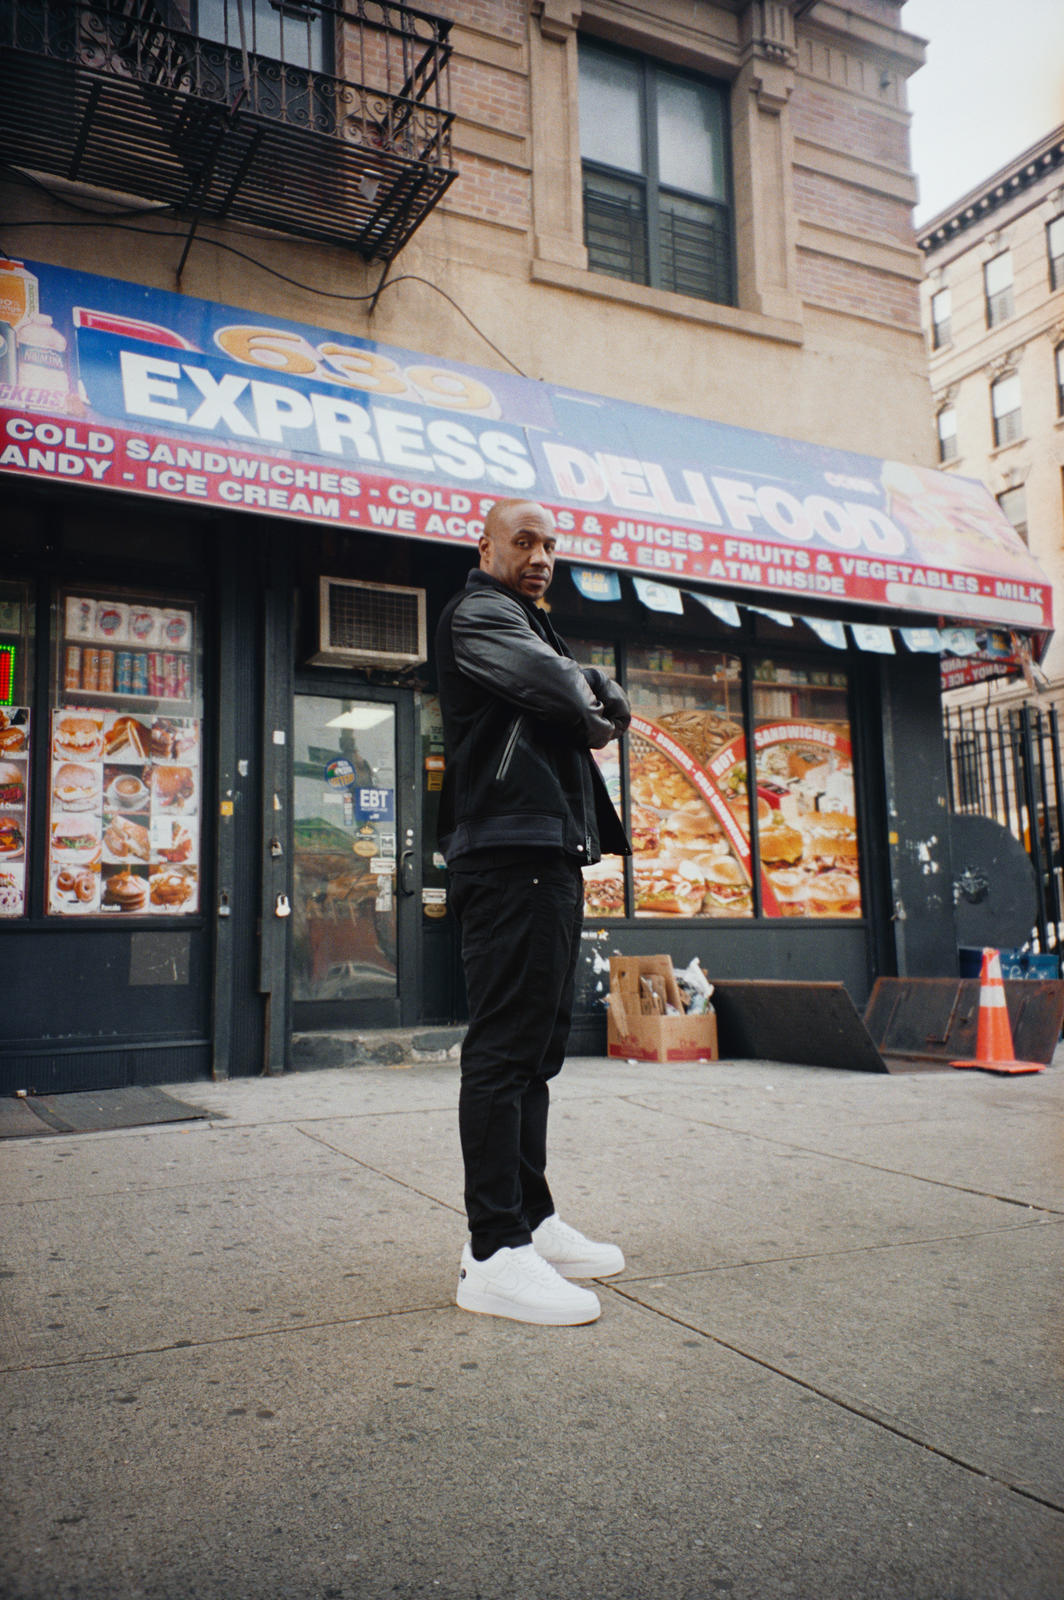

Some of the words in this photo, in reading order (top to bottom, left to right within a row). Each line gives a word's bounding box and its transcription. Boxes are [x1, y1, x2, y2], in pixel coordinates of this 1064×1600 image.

[214, 325, 500, 413] 639
[119, 350, 536, 490] EXPRESS
[541, 441, 724, 527] DELI
[711, 475, 906, 556] FOOD
[5, 418, 114, 453] COLD
[126, 438, 360, 497] SANDWICHES
[387, 485, 472, 514] COLD
[582, 515, 602, 536] &
[610, 520, 704, 552] JUICES
[724, 539, 810, 572] FRUITS
[816, 553, 833, 574] &
[838, 556, 979, 594] VEGETABLES
[995, 581, 1045, 605] MILK
[147, 468, 208, 496] ICE
[217, 480, 340, 518] CREAM
[367, 504, 416, 531] WE
[425, 512, 485, 539] ACC
[609, 542, 629, 563] &
[637, 546, 688, 572] EBT
[708, 558, 761, 583] ATM
[768, 567, 845, 595] INSIDE
[360, 789, 388, 808] EBT
[711, 748, 736, 777] HOT
[754, 725, 837, 747] SANDWICHES
